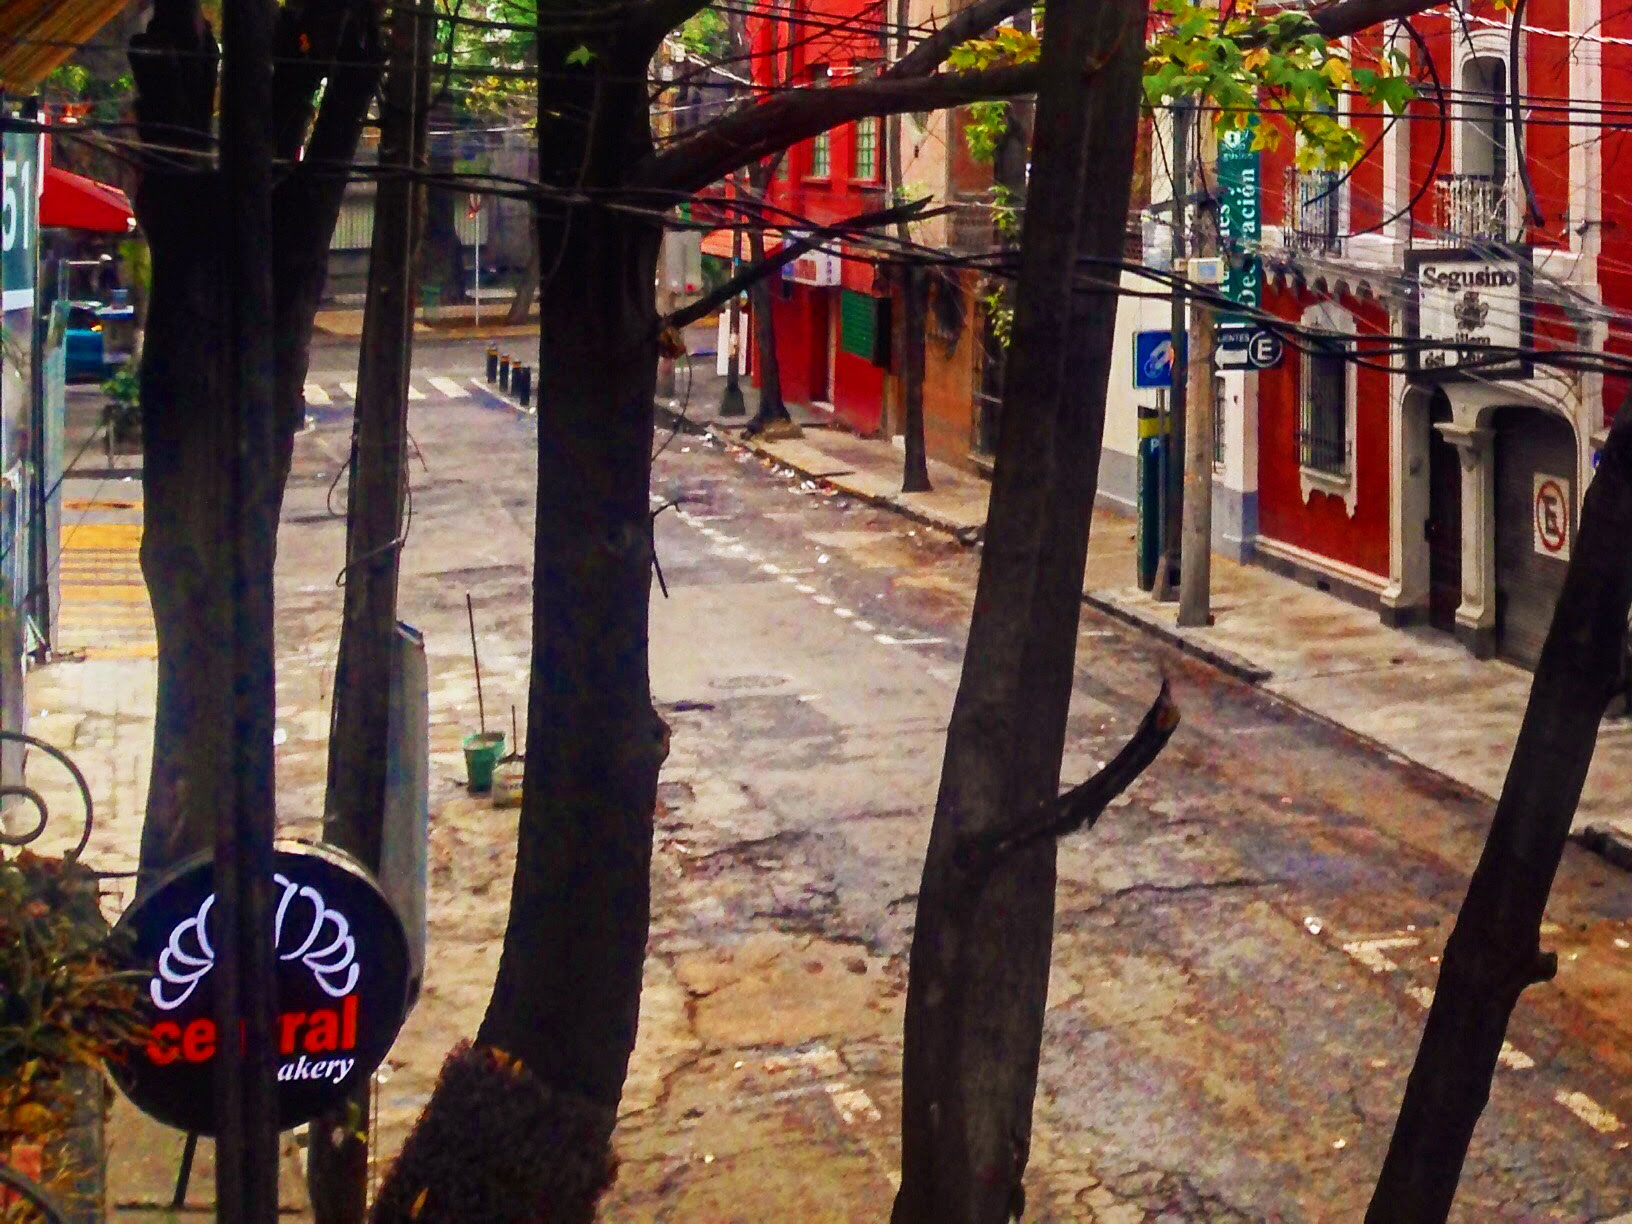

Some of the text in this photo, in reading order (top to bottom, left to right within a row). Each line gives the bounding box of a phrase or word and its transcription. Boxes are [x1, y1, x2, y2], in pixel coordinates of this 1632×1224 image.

[1421, 266, 1517, 293] Segusino
[146, 994, 359, 1067] ceral
[277, 1054, 355, 1084] akery
